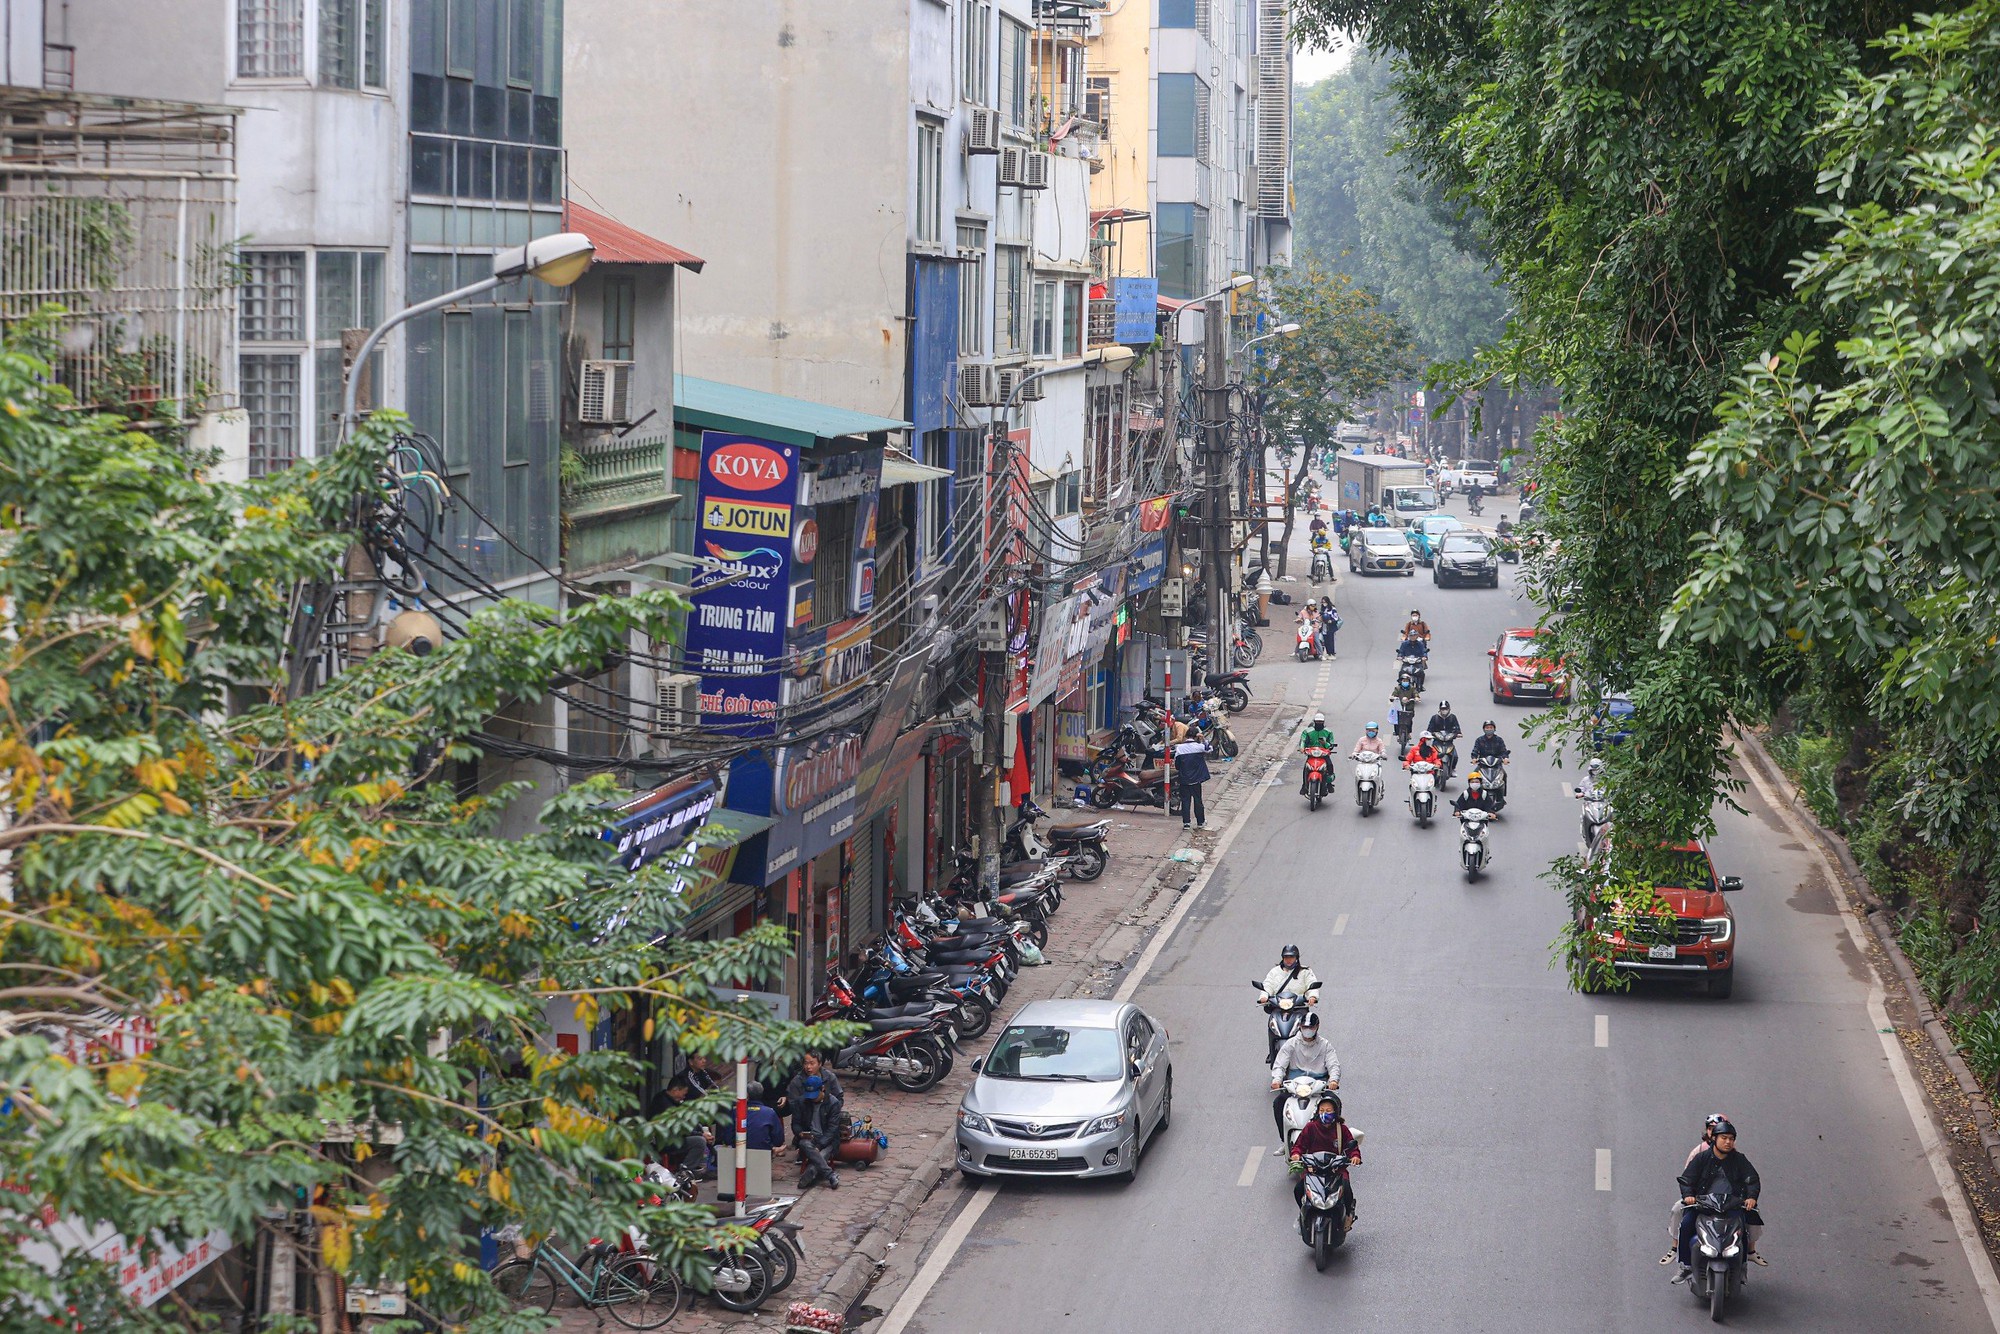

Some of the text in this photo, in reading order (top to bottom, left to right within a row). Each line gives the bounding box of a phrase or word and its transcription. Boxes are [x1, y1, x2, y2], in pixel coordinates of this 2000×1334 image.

[714, 454, 781, 480] KOVA
[726, 508, 787, 532] JOTUN
[800, 532, 817, 553] KOVA
[703, 556, 771, 579] Dulux
[700, 604, 743, 630] TRUNG
[746, 606, 775, 633] TÂM
[702, 648, 764, 675] PHA MÀU
[700, 688, 724, 712] THẾ
